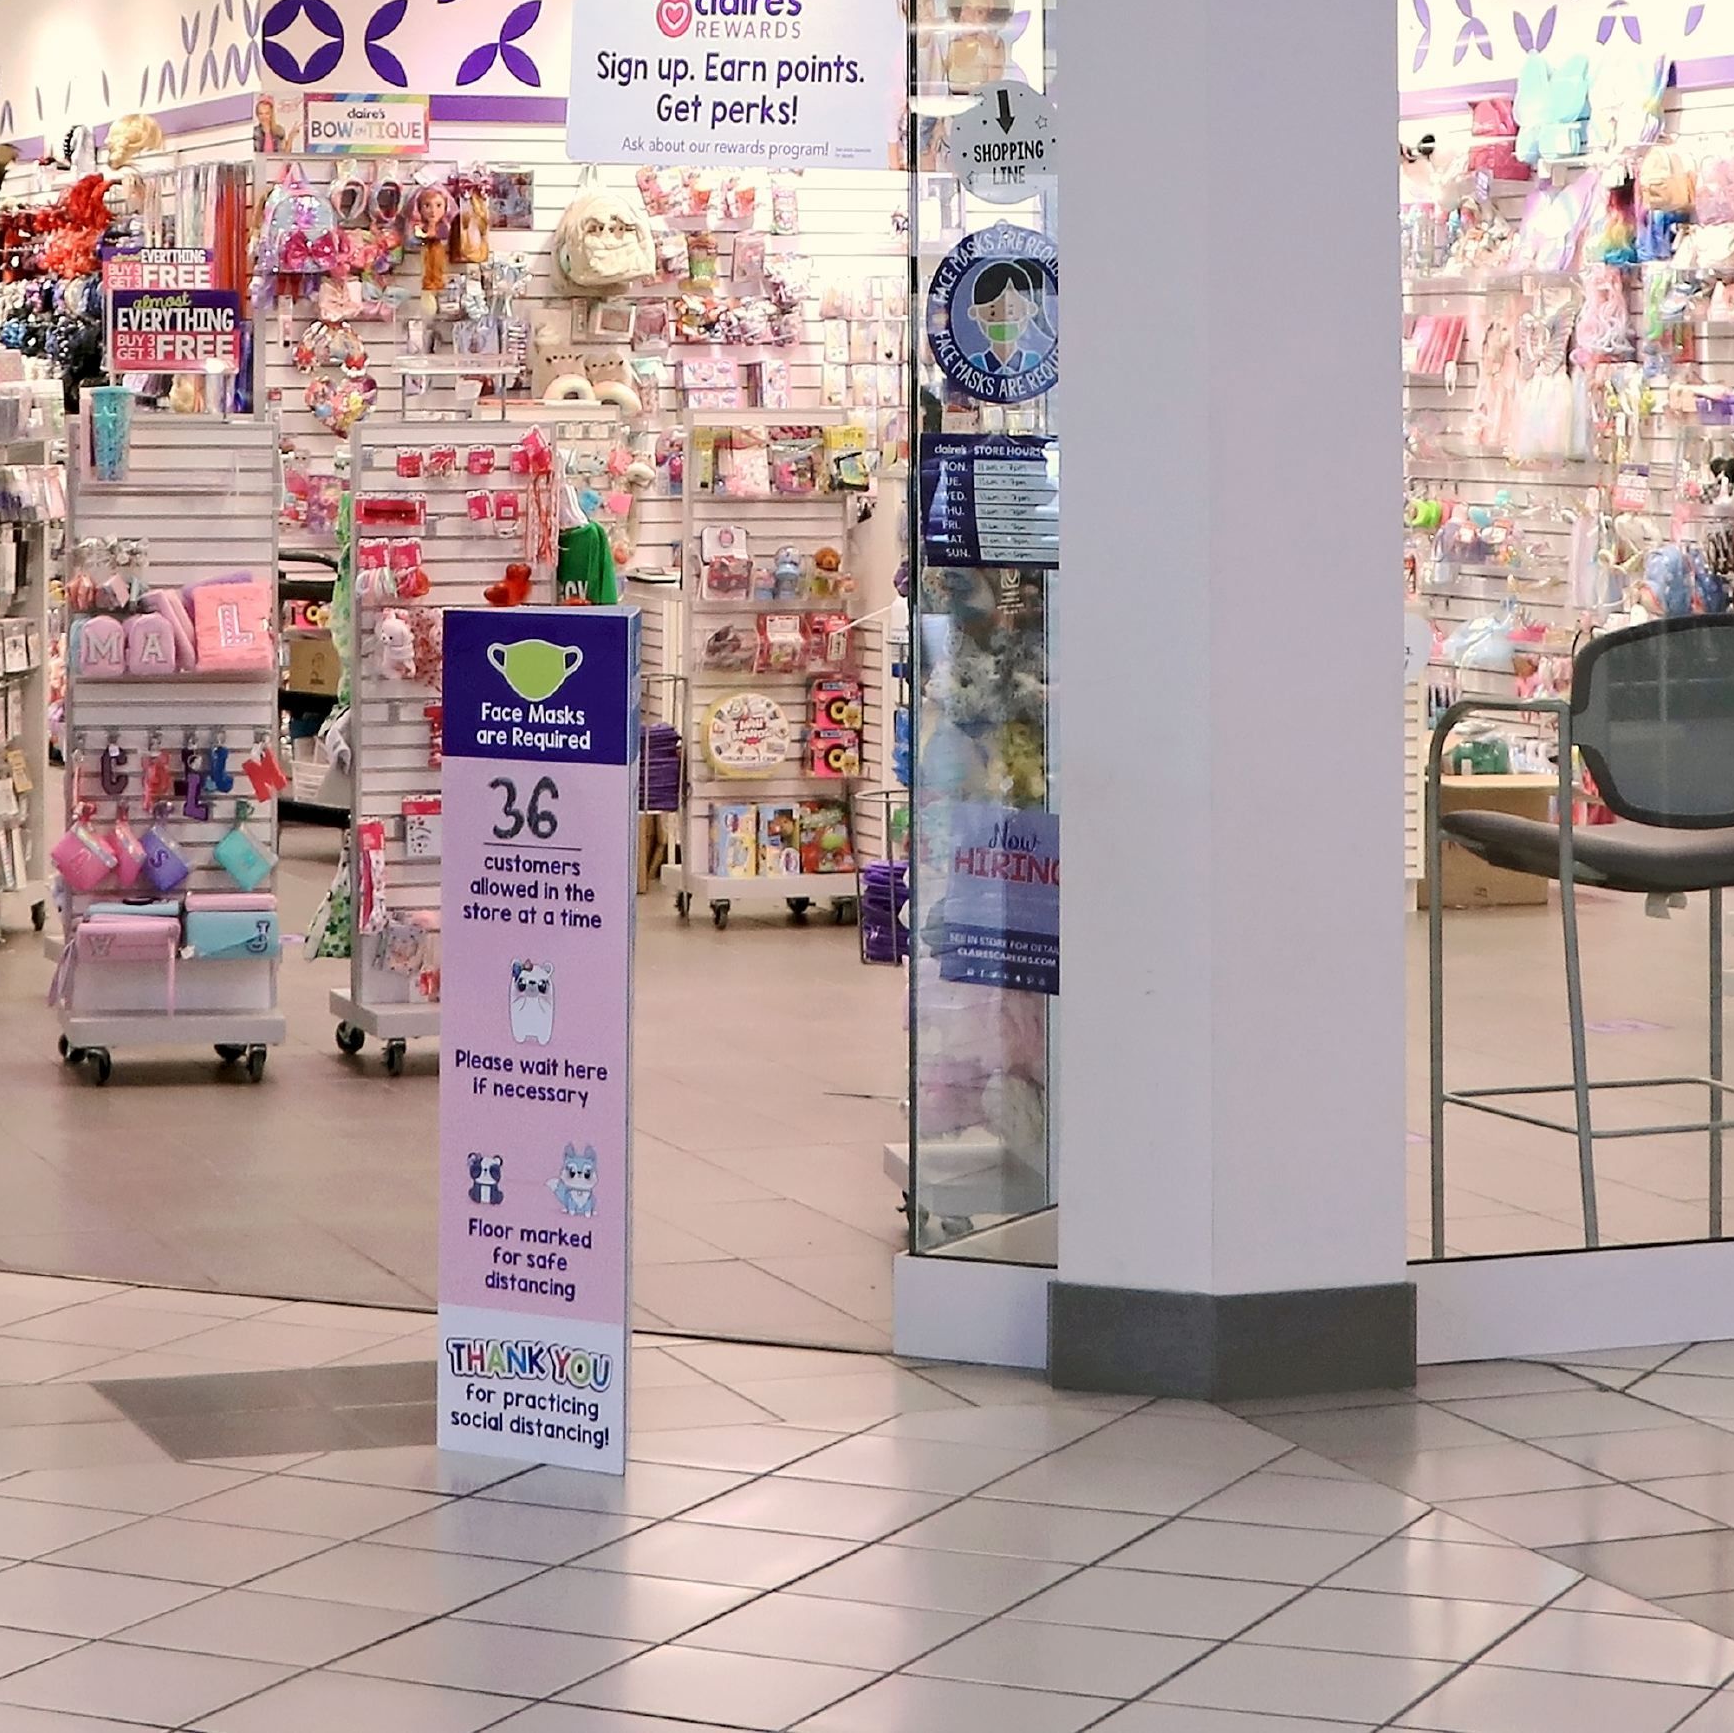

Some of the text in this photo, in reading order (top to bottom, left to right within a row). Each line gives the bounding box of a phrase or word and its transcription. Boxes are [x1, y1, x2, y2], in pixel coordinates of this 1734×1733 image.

[695, 20, 801, 39] REWARDS
[597, 51, 865, 88] Sign up. Earn points.
[347, 107, 386, 120] claire's
[657, 93, 799, 129] Get perks!
[622, 136, 645, 151] Ask
[649, 137, 685, 153] about
[689, 142, 711, 154] our
[715, 139, 765, 156] rewards
[769, 142, 829, 160] program!
[973, 139, 1044, 163] SHOPPING
[992, 165, 1026, 185] LINE
[141, 249, 206, 264] EVERYTHING
[932, 265, 959, 304] FACE
[950, 233, 994, 272] MASKS
[997, 229, 1025, 250] ARE
[108, 264, 142, 276] BUY 3
[108, 276, 142, 288] GET 3
[142, 264, 212, 289] FREE
[133, 291, 191, 310] almost
[118, 307, 234, 332] EVERYTHING
[117, 334, 155, 347] BUY 3
[156, 334, 235, 361] FREE
[117, 348, 155, 360] GET 3
[933, 329, 958, 366] FACE
[951, 363, 995, 397] MASKS
[999, 378, 1025, 399] ARE
[934, 444, 1042, 457] claire's STORE HOURS
[946, 548, 971, 558] SUN.
[481, 702, 585, 726] Face Masks
[476, 727, 591, 752] are Required
[488, 775, 559, 839] 36
[989, 819, 1040, 852] Now
[484, 854, 581, 877] customers
[470, 877, 595, 903] allowed in the
[463, 902, 602, 929] store at a time
[980, 936, 1007, 949] STORE
[455, 1049, 608, 1081] Please wait here
[473, 1076, 589, 1108] if necessary
[468, 1218, 592, 1250] Floor marked
[492, 1246, 568, 1271] for safe
[485, 1272, 576, 1303] distancing
[447, 1338, 612, 1392] THANK YOU
[466, 1384, 600, 1422] for practicing
[451, 1409, 610, 1450] social distancing!
